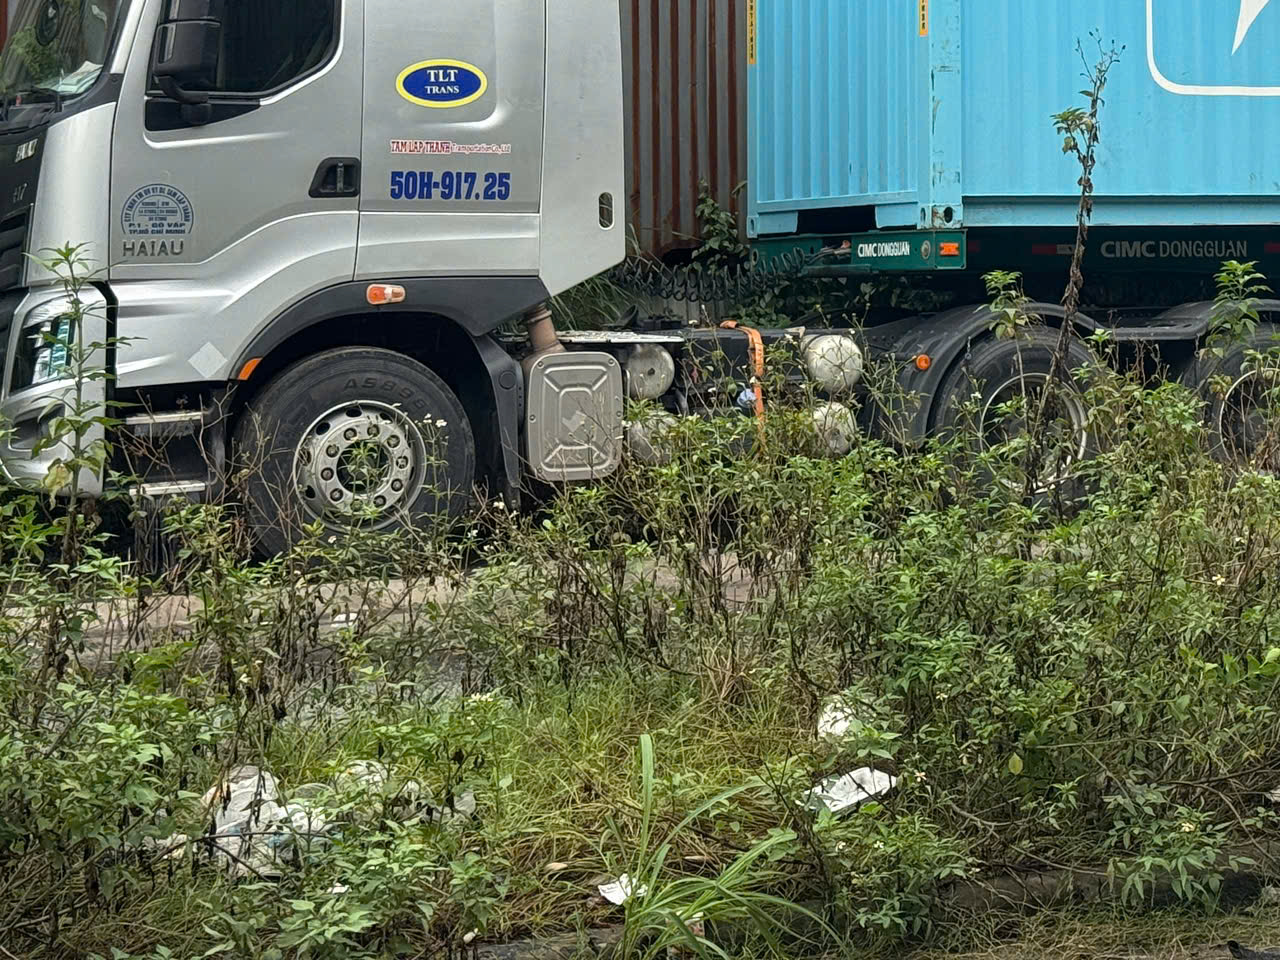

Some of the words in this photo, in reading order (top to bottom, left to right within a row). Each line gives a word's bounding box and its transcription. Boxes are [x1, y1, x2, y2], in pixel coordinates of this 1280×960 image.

[426, 69, 459, 83] TLT
[424, 85, 460, 95] TRANS
[390, 170, 511, 200] 50H-917.25
[122, 240, 184, 257] HAIAU
[858, 243, 877, 257] CIMC
[878, 241, 910, 257] DONGGUAN
[1100, 240, 1156, 258] CIMC
[1159, 240, 1248, 258] DONGGUAN
